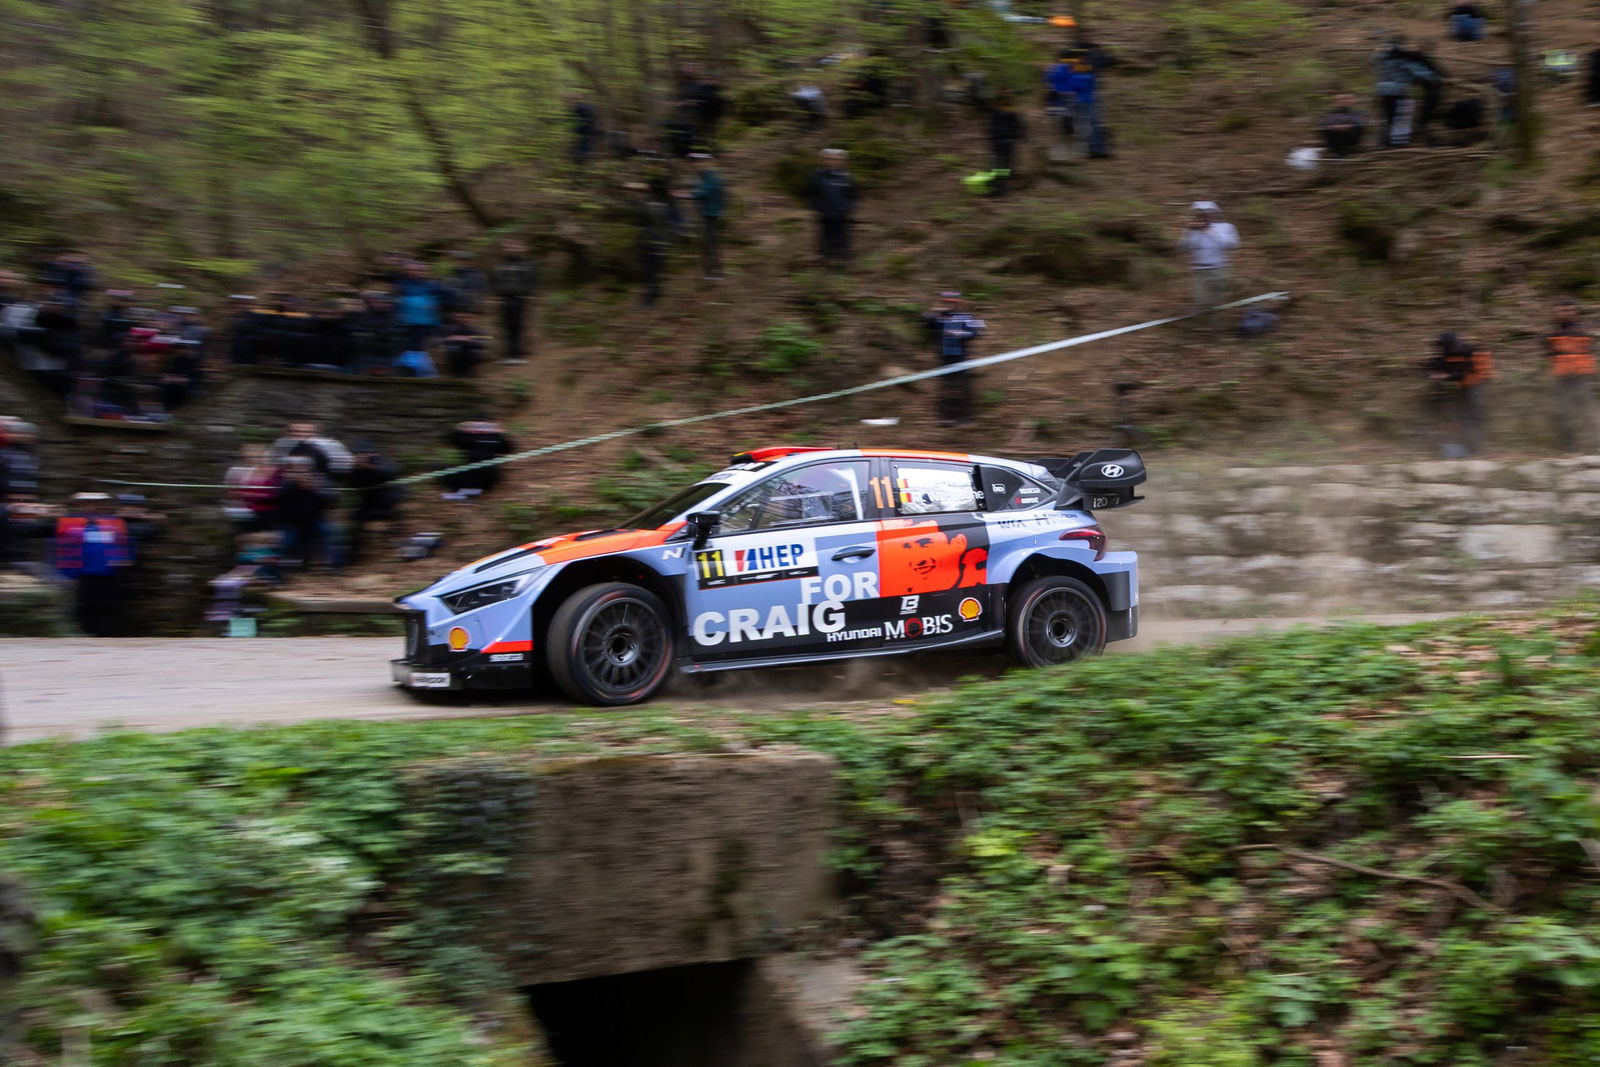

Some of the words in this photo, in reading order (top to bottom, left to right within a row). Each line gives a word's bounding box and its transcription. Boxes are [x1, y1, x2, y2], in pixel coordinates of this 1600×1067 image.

[869, 477, 895, 509] 11
[698, 551, 724, 578] 11
[801, 571, 880, 604] FOR
[693, 601, 846, 646] CRAIG
[827, 627, 883, 642] HYUNDAI
[884, 614, 953, 640] MOBIS
